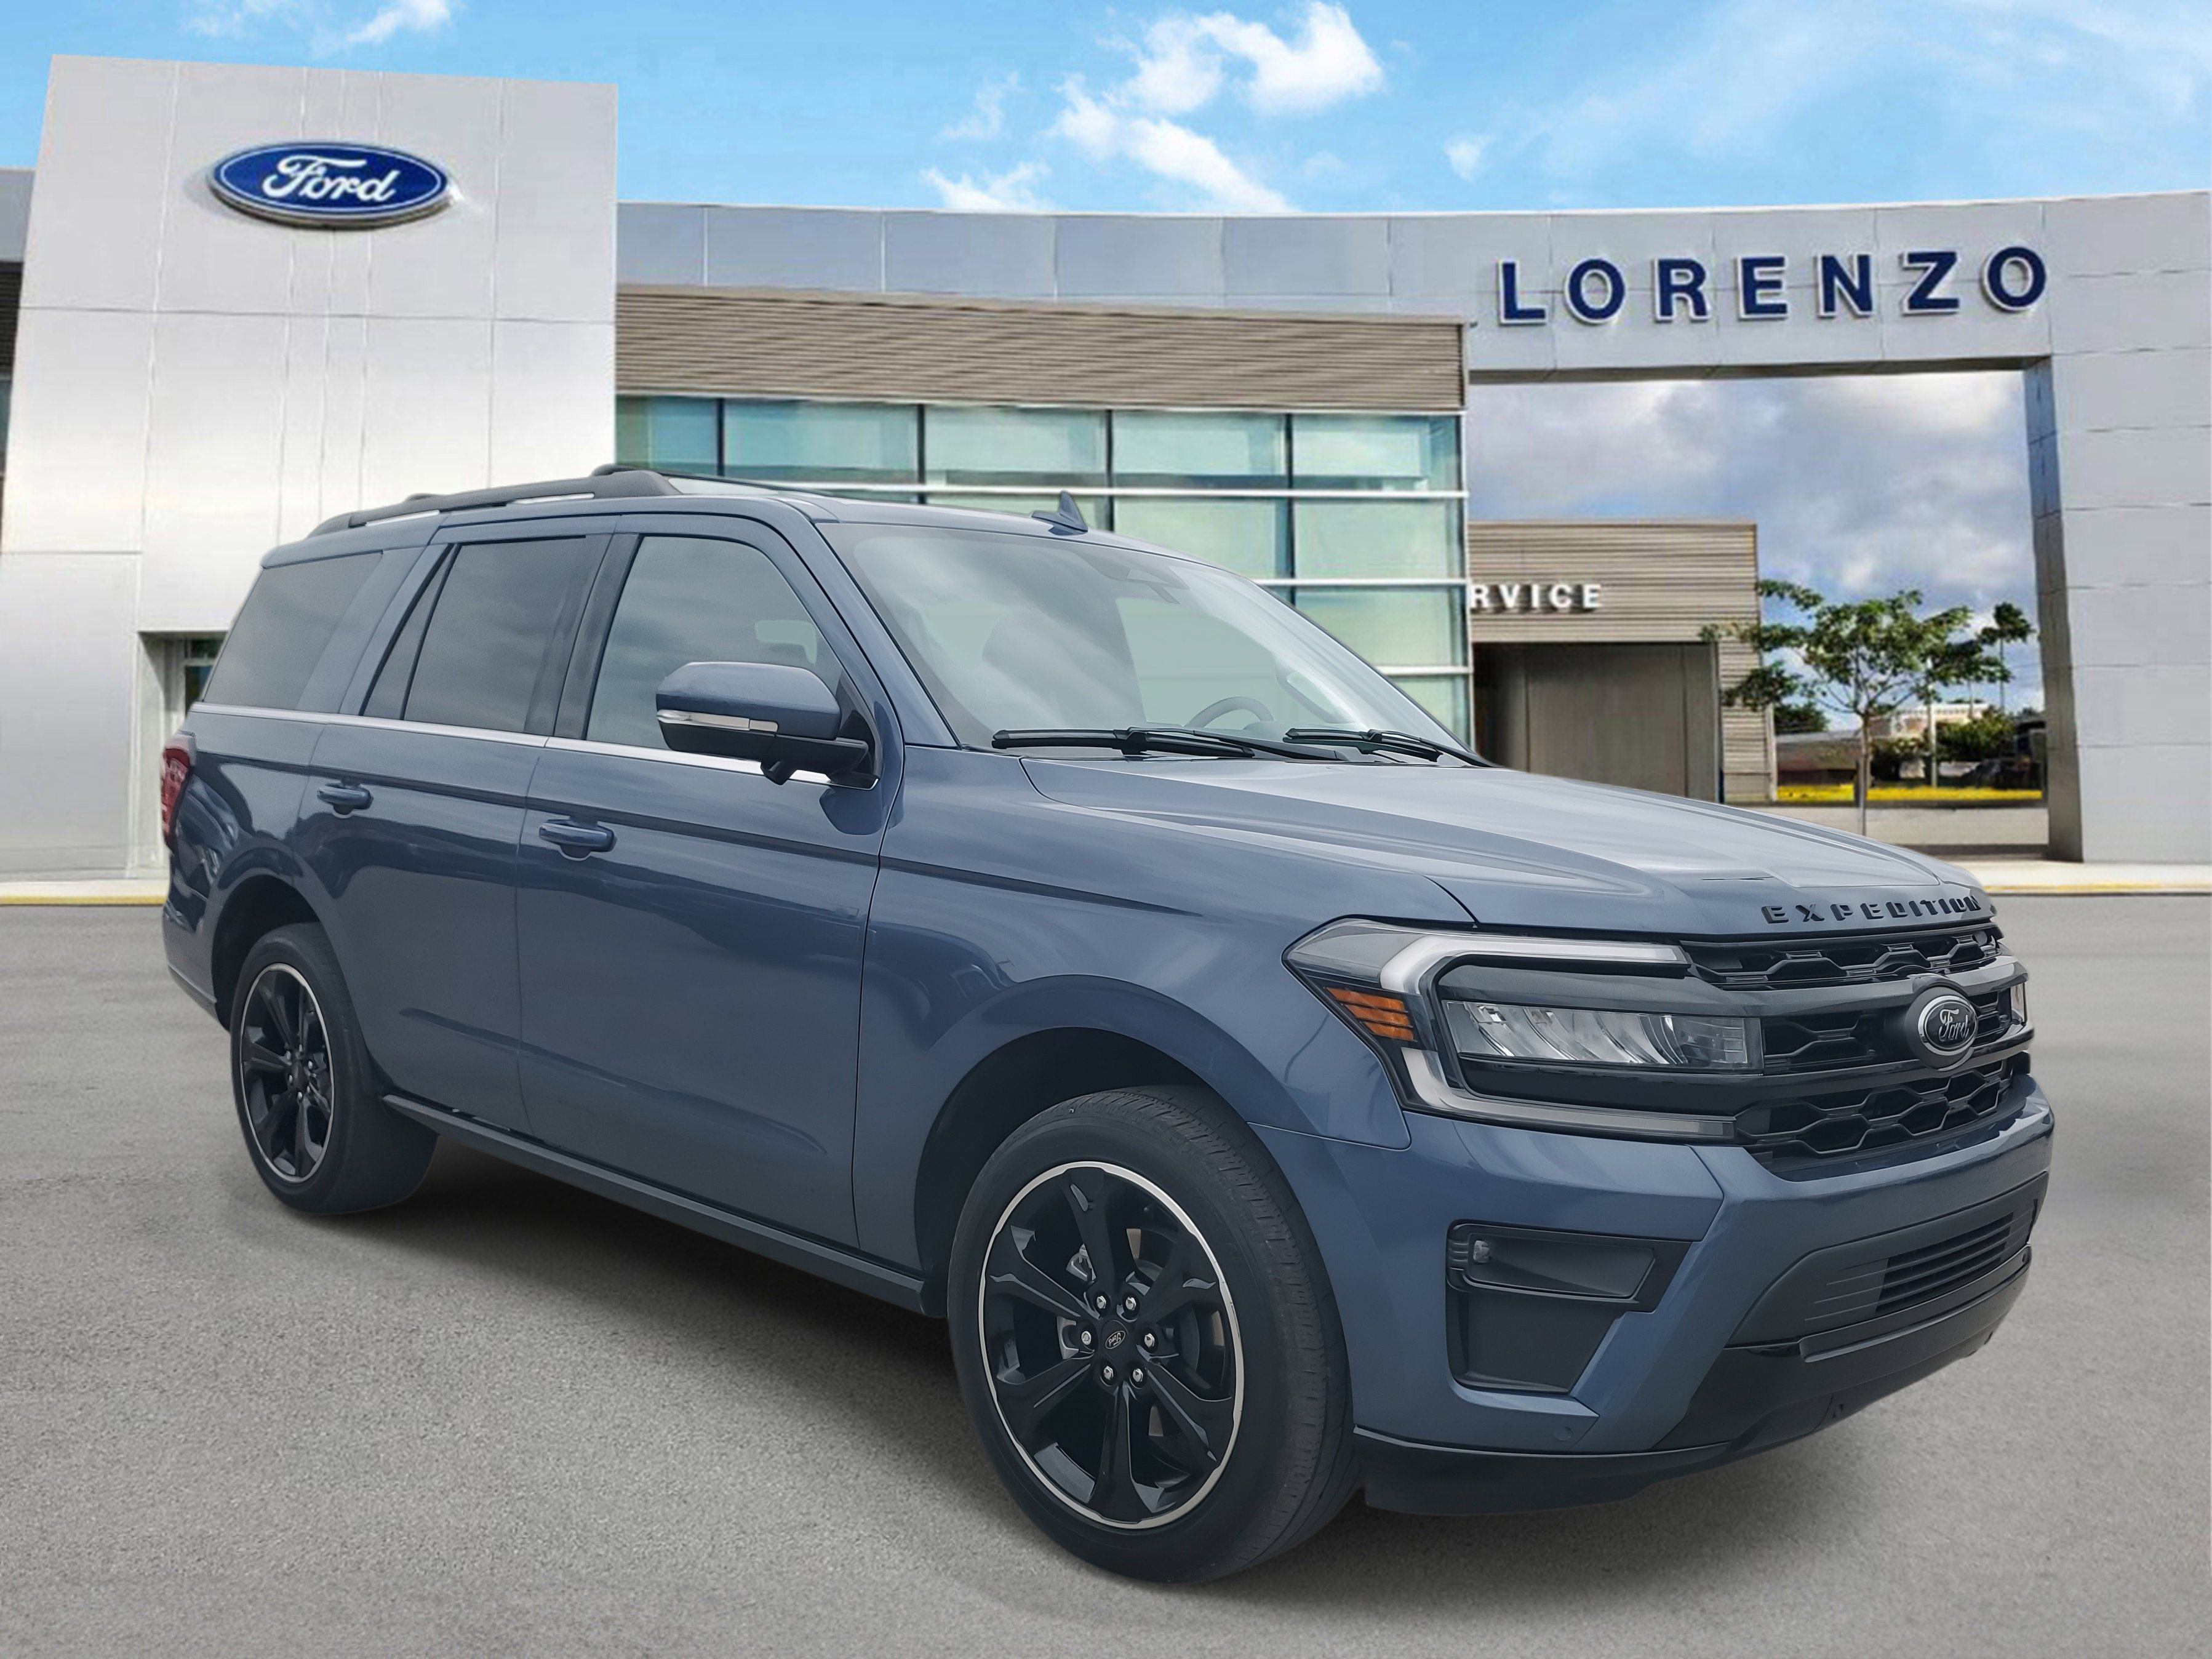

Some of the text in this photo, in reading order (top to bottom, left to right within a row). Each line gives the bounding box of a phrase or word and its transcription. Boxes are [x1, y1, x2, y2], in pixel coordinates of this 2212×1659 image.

[262, 154, 401, 202] Ford
[1498, 246, 2048, 326] LORENZO
[1469, 583, 1602, 609] RVICE
[1761, 895, 1982, 924] EXPEDITION
[1938, 1009, 1970, 1041] Ford
